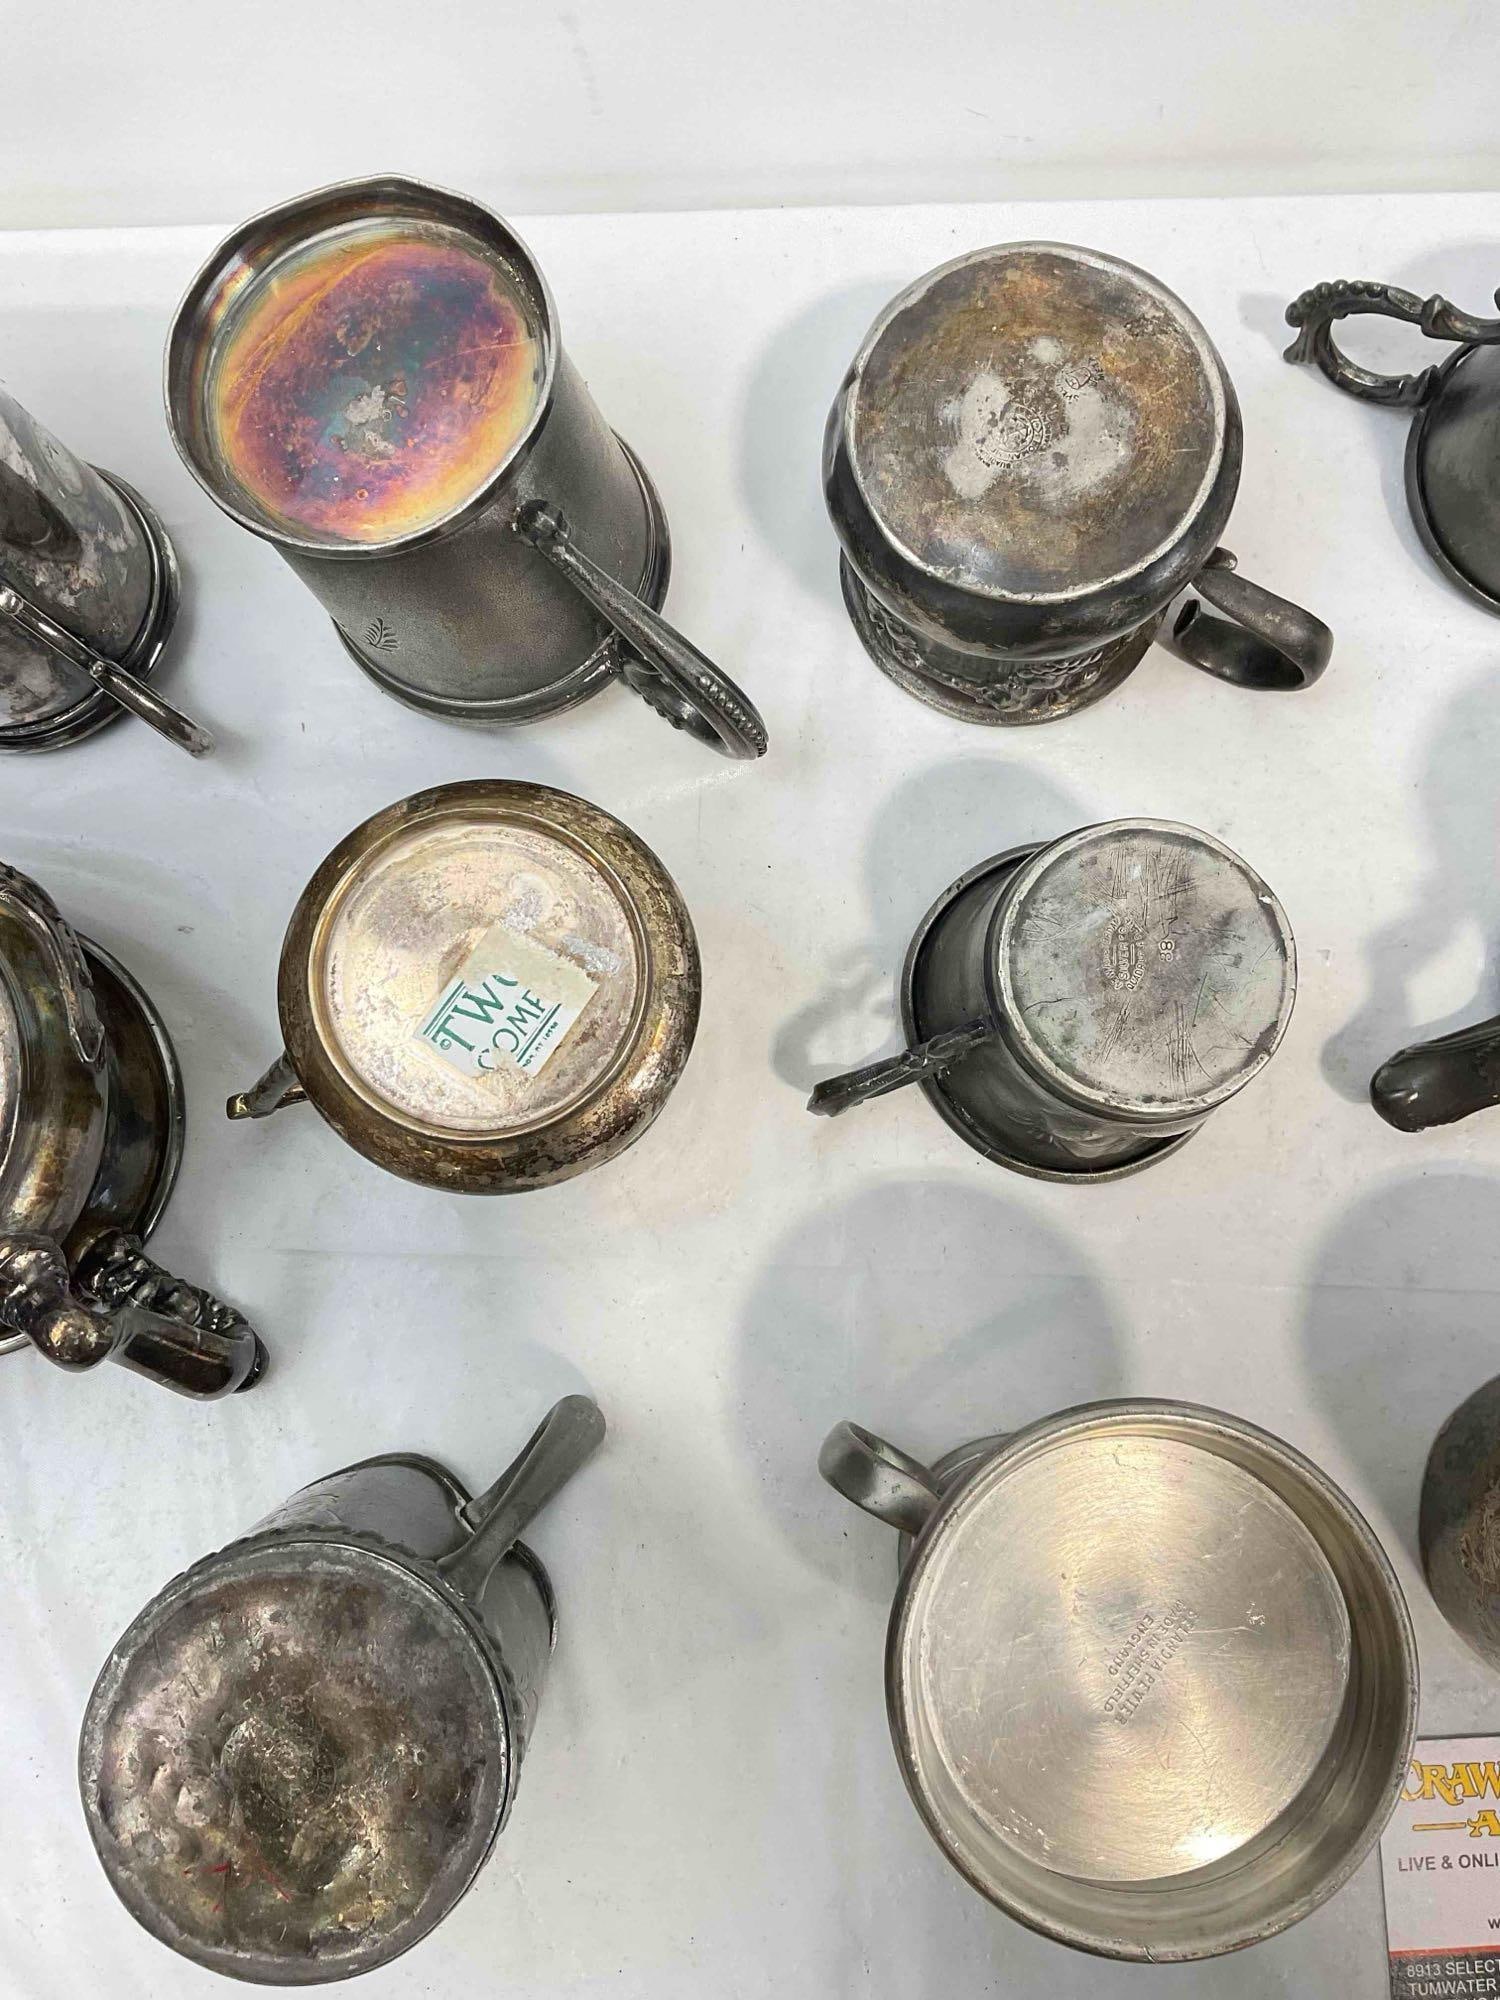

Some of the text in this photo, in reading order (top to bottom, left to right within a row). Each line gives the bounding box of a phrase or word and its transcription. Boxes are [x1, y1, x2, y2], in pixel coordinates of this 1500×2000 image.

[1117, 942, 1131, 981] SILVER
[1159, 940, 1175, 962] 38
[1104, 1599, 1188, 1713] MADE IN SHEFFIELD
[1107, 1614, 1154, 1676] ENGLAND
[1114, 1672, 1156, 1725] PEWTER
[1398, 1852, 1500, 1872] LIVE & ONLI
[1407, 1963, 1441, 1978] 8913
[1408, 1978, 1497, 1996] TUMWATER
